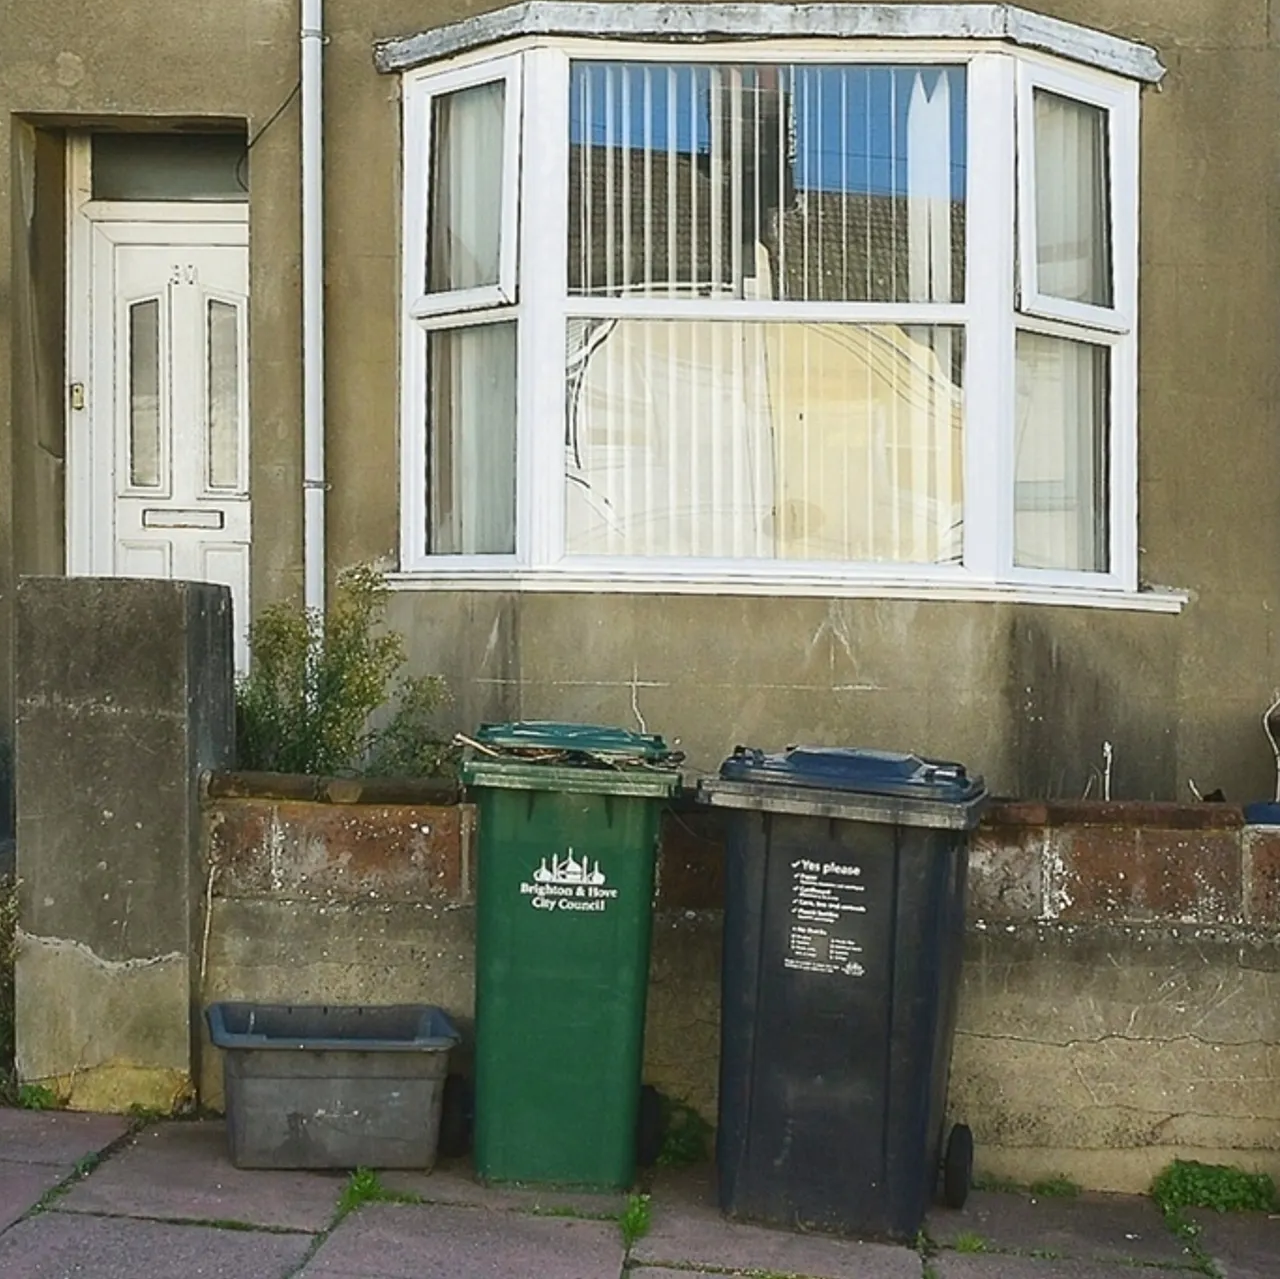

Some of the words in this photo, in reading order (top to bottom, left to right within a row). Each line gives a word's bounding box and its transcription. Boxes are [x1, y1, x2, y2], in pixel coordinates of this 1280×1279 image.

[801, 859, 820, 872] Yes
[822, 862, 861, 876] please
[520, 882, 573, 896] Brighton
[575, 886, 585, 897] &
[588, 886, 618, 898] Hove
[532, 896, 556, 911] City
[558, 898, 605, 911] Council
